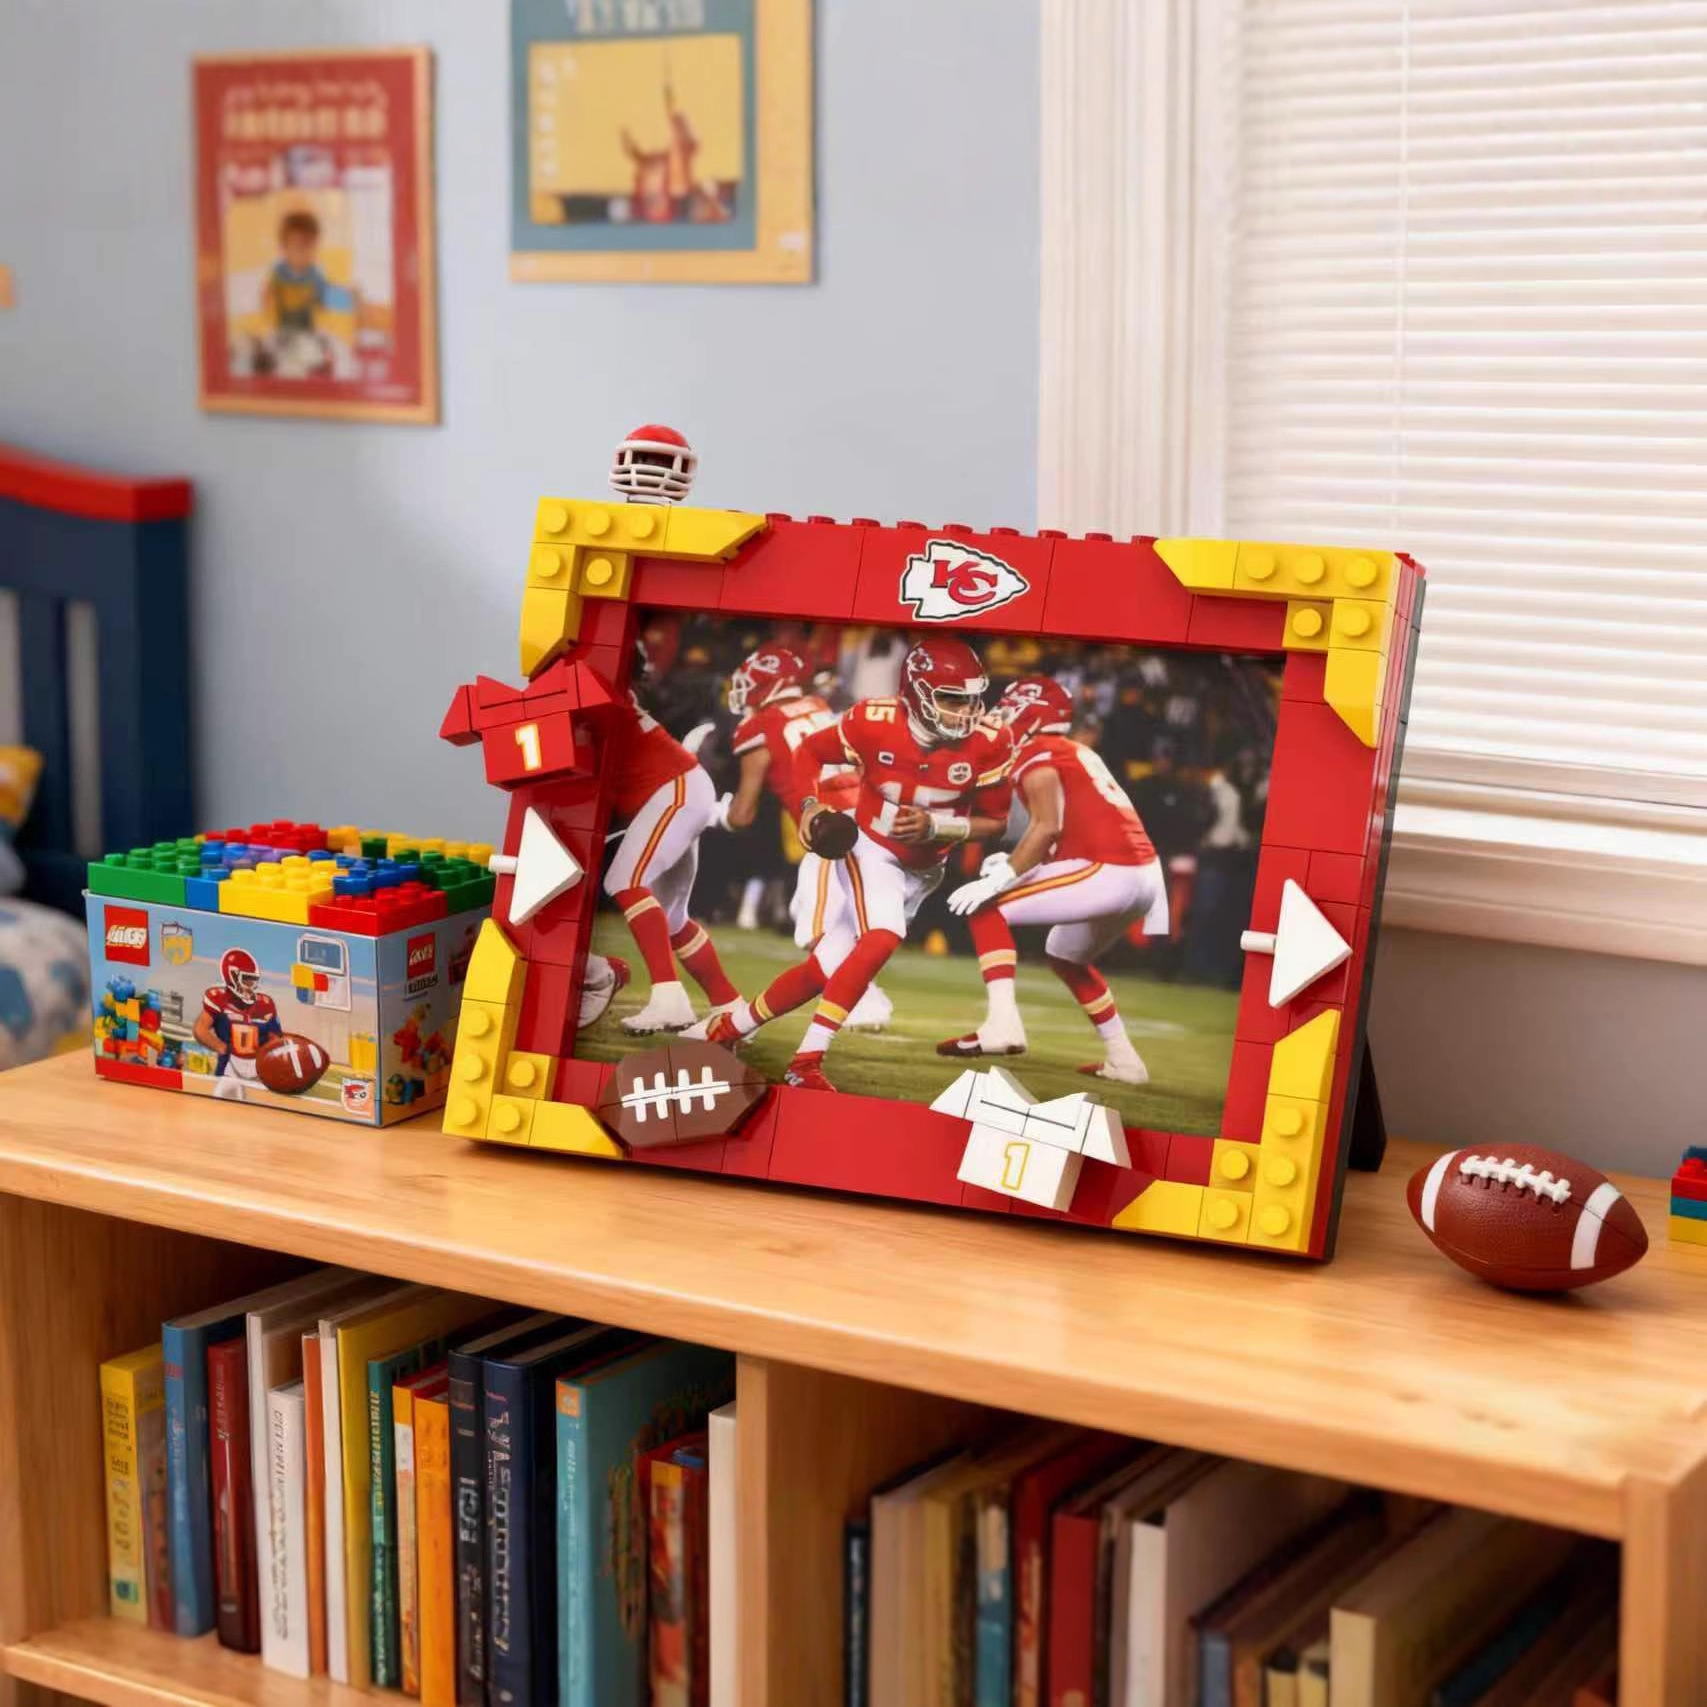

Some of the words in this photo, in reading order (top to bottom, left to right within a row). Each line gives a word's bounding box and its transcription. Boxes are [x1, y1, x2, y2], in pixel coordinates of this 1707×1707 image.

[930, 559, 999, 605] KC
[515, 723, 542, 771] 1
[1001, 1141, 1031, 1191] 1
